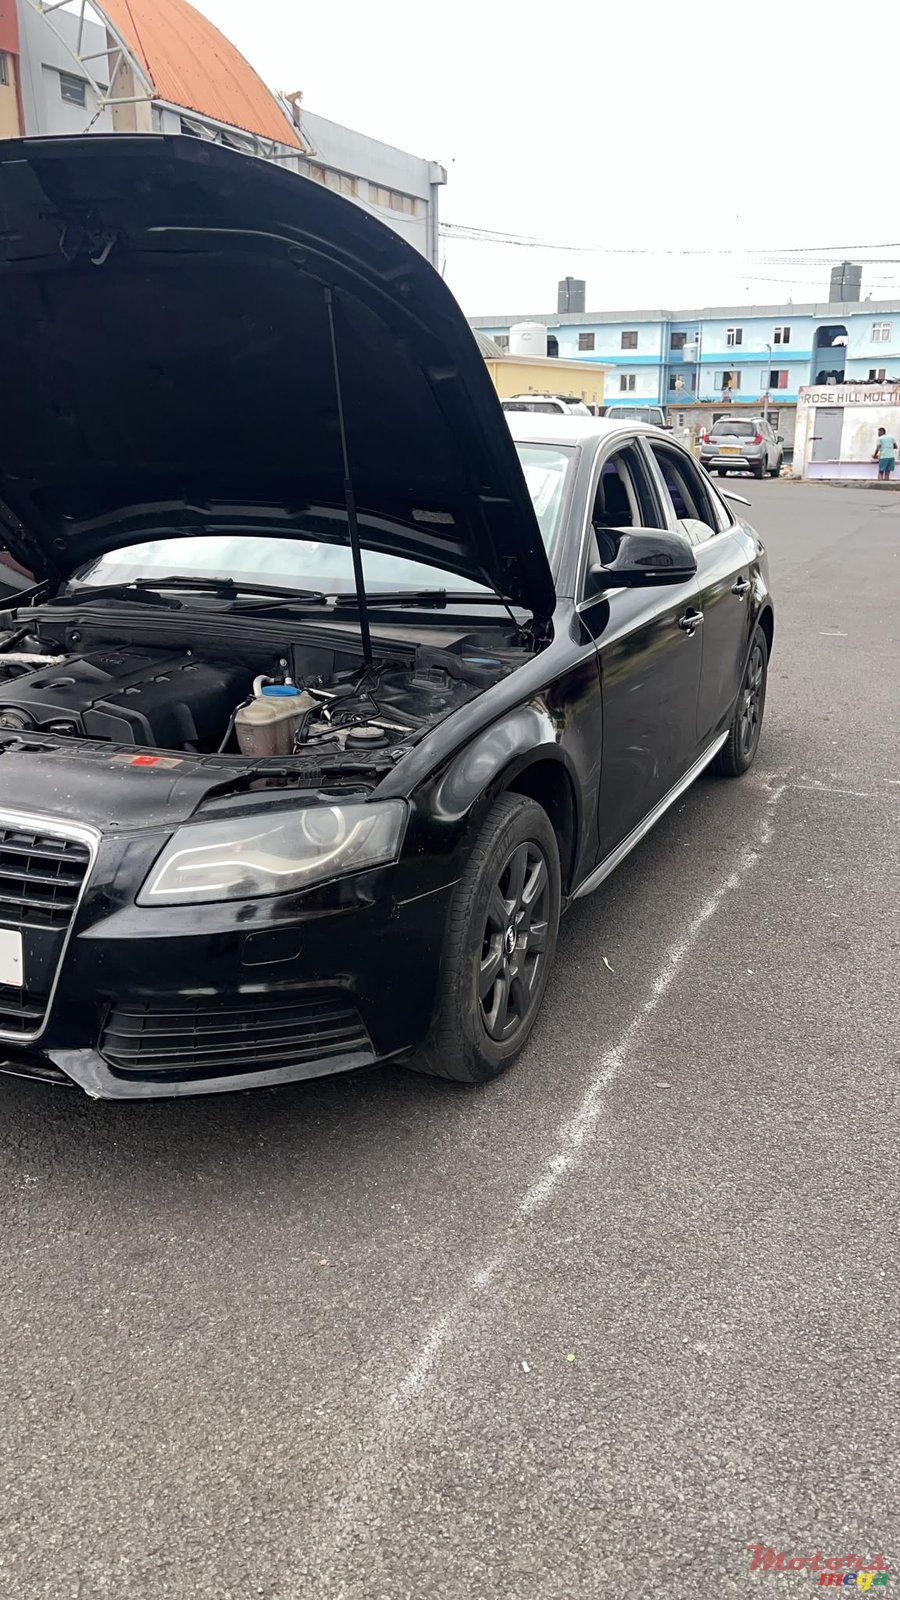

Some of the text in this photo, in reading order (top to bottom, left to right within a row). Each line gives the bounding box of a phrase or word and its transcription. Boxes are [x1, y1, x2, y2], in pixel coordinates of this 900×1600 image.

[804, 391, 900, 404] ROSE HILL MULTI
